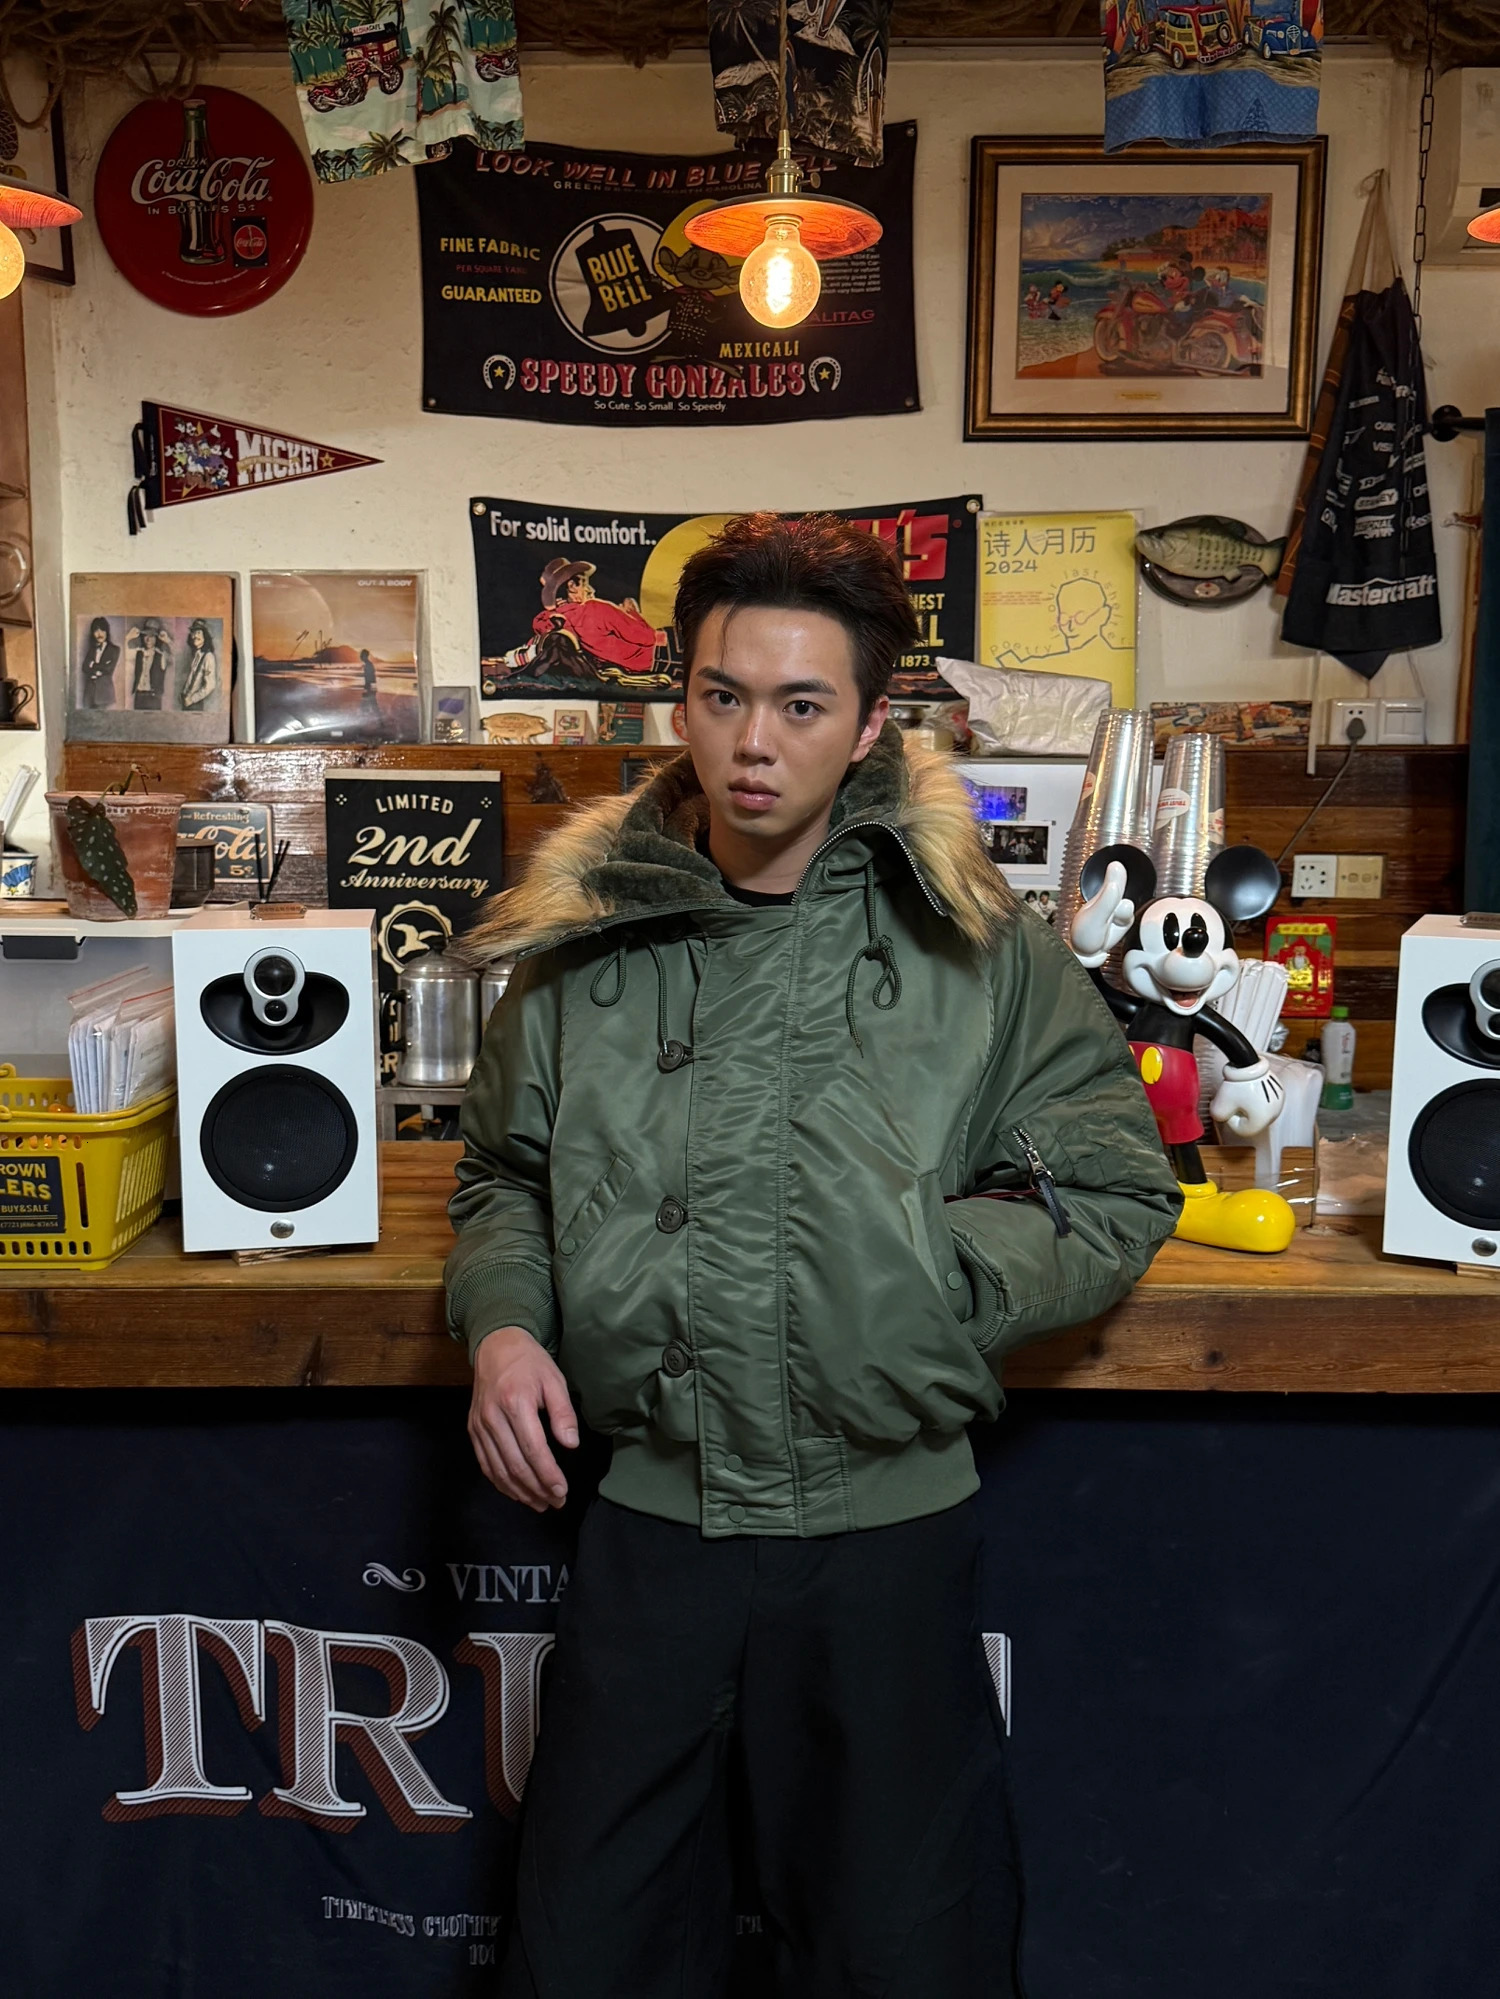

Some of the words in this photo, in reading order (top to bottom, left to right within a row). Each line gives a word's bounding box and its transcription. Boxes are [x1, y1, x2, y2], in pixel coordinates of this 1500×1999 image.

[167, 158, 208, 169] DRINK
[476, 150, 554, 177] LOOK
[563, 161, 637, 188] WELL
[647, 167, 678, 190] IN
[686, 161, 762, 188] BLUE
[148, 206, 160, 215] IN
[440, 238, 475, 253] FINE
[478, 238, 541, 261] FABRIC
[456, 264, 471, 273] PER
[474, 264, 502, 274] SQUARE
[586, 243, 640, 285] BLUE
[441, 285, 543, 304] GUARANTEED
[598, 275, 653, 314] BELL
[719, 340, 801, 359] MEXICALI
[520, 358, 638, 398] SPEEDY
[645, 361, 806, 400] GONZALES
[594, 400, 607, 410] So
[634, 401, 647, 411] So
[678, 401, 691, 412] So
[234, 428, 320, 487] MICKEY
[490, 510, 522, 537] For
[525, 516, 571, 542] solid
[984, 526, 1096, 557] 诗人月历
[985, 559, 1038, 576] 2024
[387, 579, 413, 587] BODY
[989, 640, 1052, 657] poetry
[1048, 584, 1059, 612] our
[1064, 568, 1100, 580] last
[901, 655, 930, 668] 1873
[376, 794, 454, 815] LIMITED
[193, 812, 249, 823] Refreshing
[347, 818, 483, 867] 2nd
[340, 868, 490, 899] Anniversary
[1, 1204, 49, 1213] BUY&SALE
[321, 1895, 416, 1937] TIMELESS
